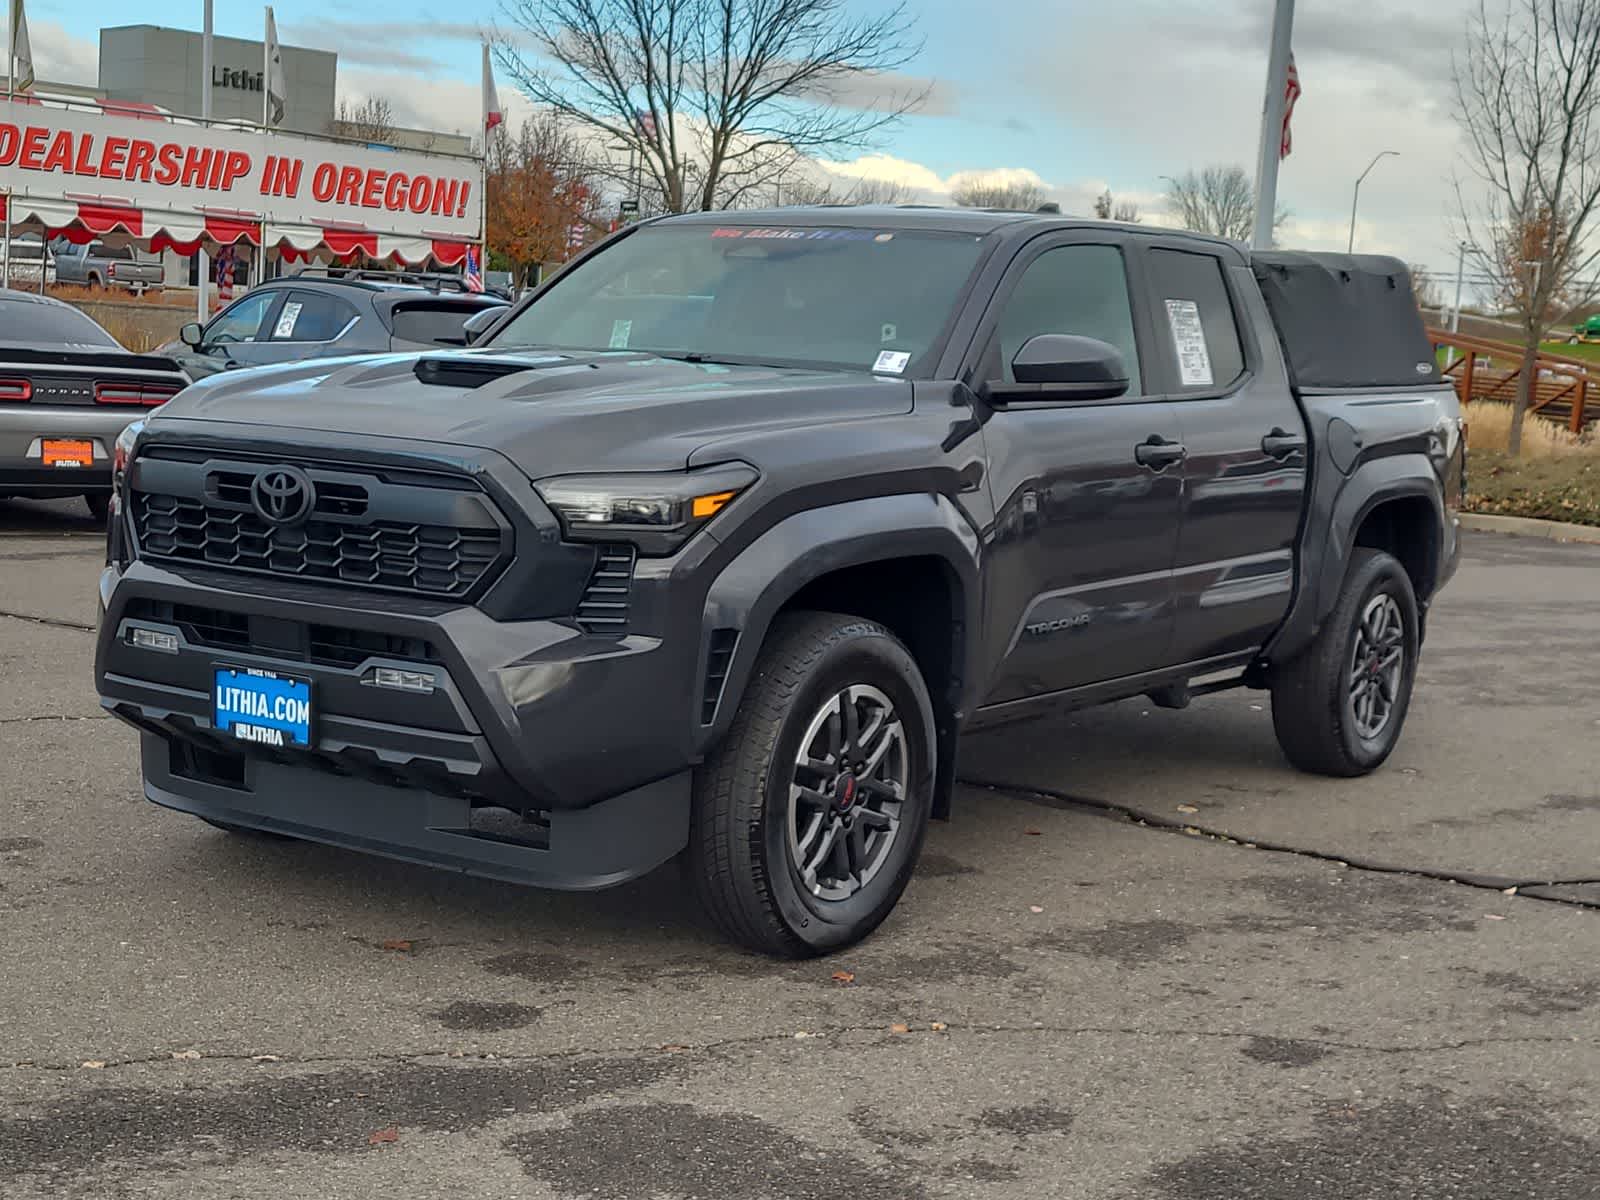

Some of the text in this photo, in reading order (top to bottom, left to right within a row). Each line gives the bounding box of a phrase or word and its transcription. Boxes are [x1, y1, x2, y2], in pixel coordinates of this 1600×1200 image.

[212, 65, 264, 92] Lithi
[0, 123, 471, 218] DEALERSHIP IN OREGON!
[744, 229, 804, 239] Make
[1026, 614, 1089, 634] TACOMA
[216, 685, 310, 725] LITHIA.COM
[247, 724, 284, 746] LITHIA
